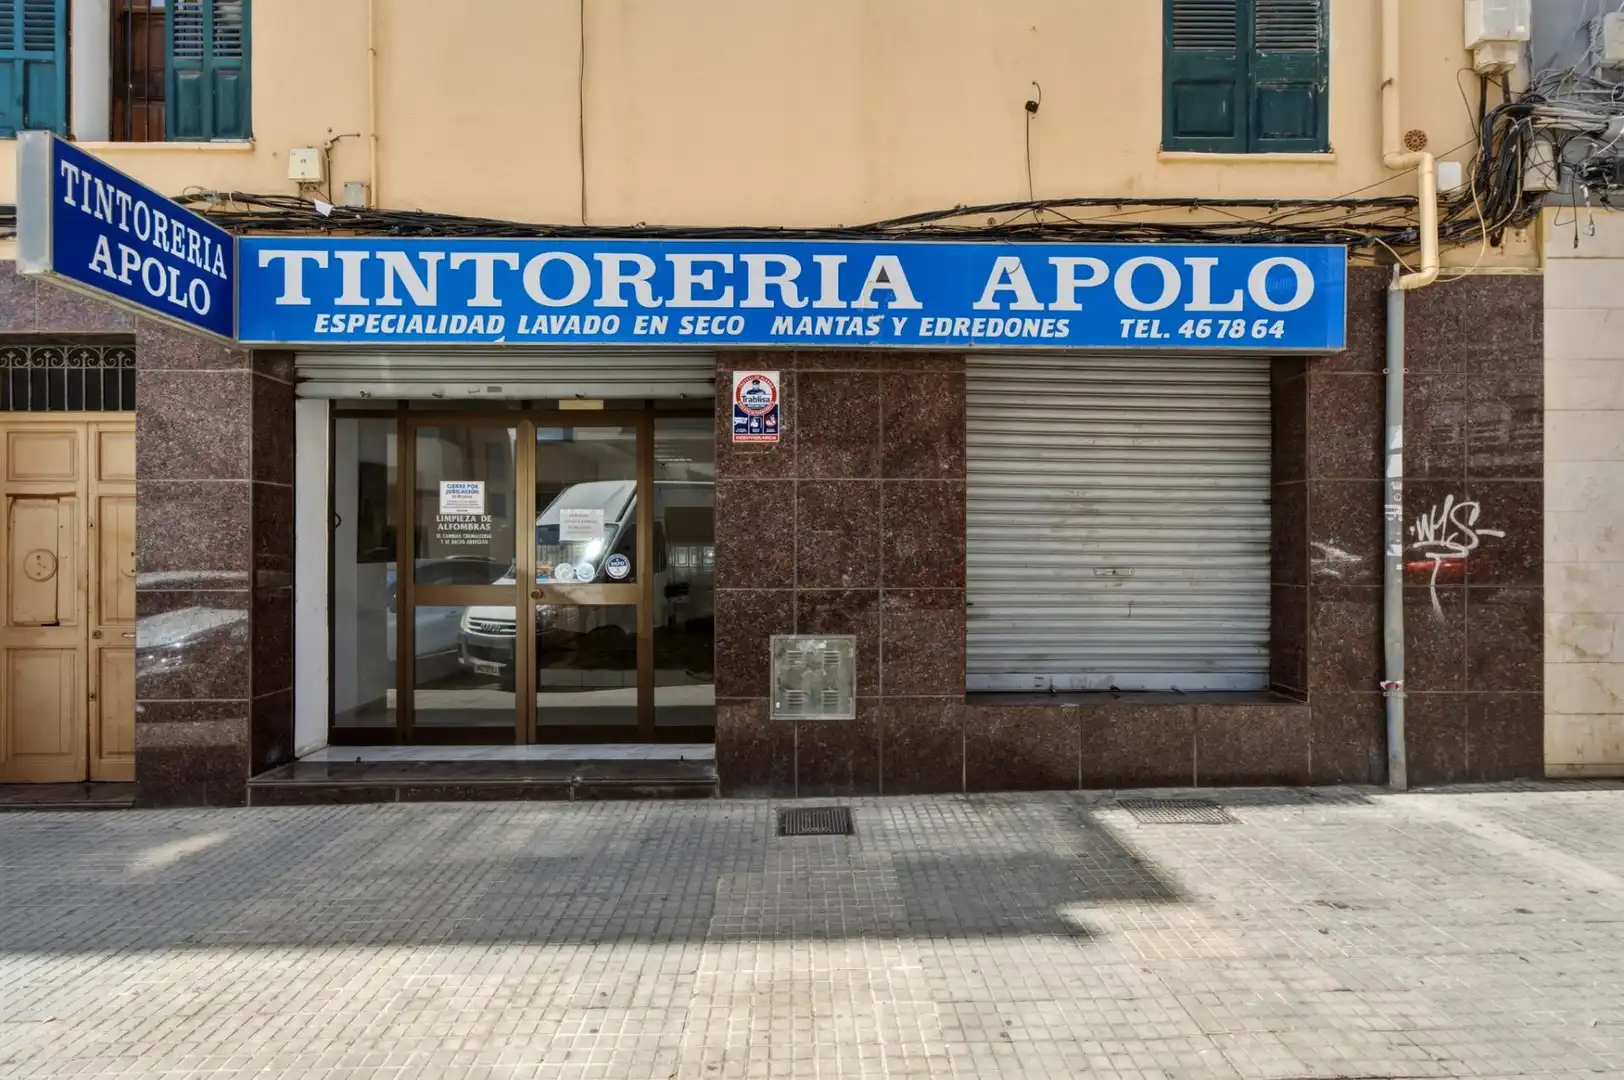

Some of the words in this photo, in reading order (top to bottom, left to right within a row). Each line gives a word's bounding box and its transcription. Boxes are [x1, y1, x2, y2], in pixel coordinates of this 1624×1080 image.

[61, 159, 227, 280] TINTORERIA
[88, 234, 211, 315] APOLO
[258, 250, 923, 311] TINTORERIA
[972, 256, 1315, 312] APOLO
[314, 313, 505, 335] ESPECIALIDAD
[517, 314, 621, 335] LAVADO
[632, 315, 668, 335] EN
[678, 315, 746, 336] SECO
[770, 315, 883, 337] MANTAS
[892, 316, 909, 336] Y
[918, 316, 1070, 338] EDREDONES
[1120, 318, 1171, 339] TEL.
[1178, 318, 1213, 339] 46
[1217, 319, 1247, 339] 78
[1250, 319, 1286, 340] 64
[741, 395, 771, 403] Trablisa
